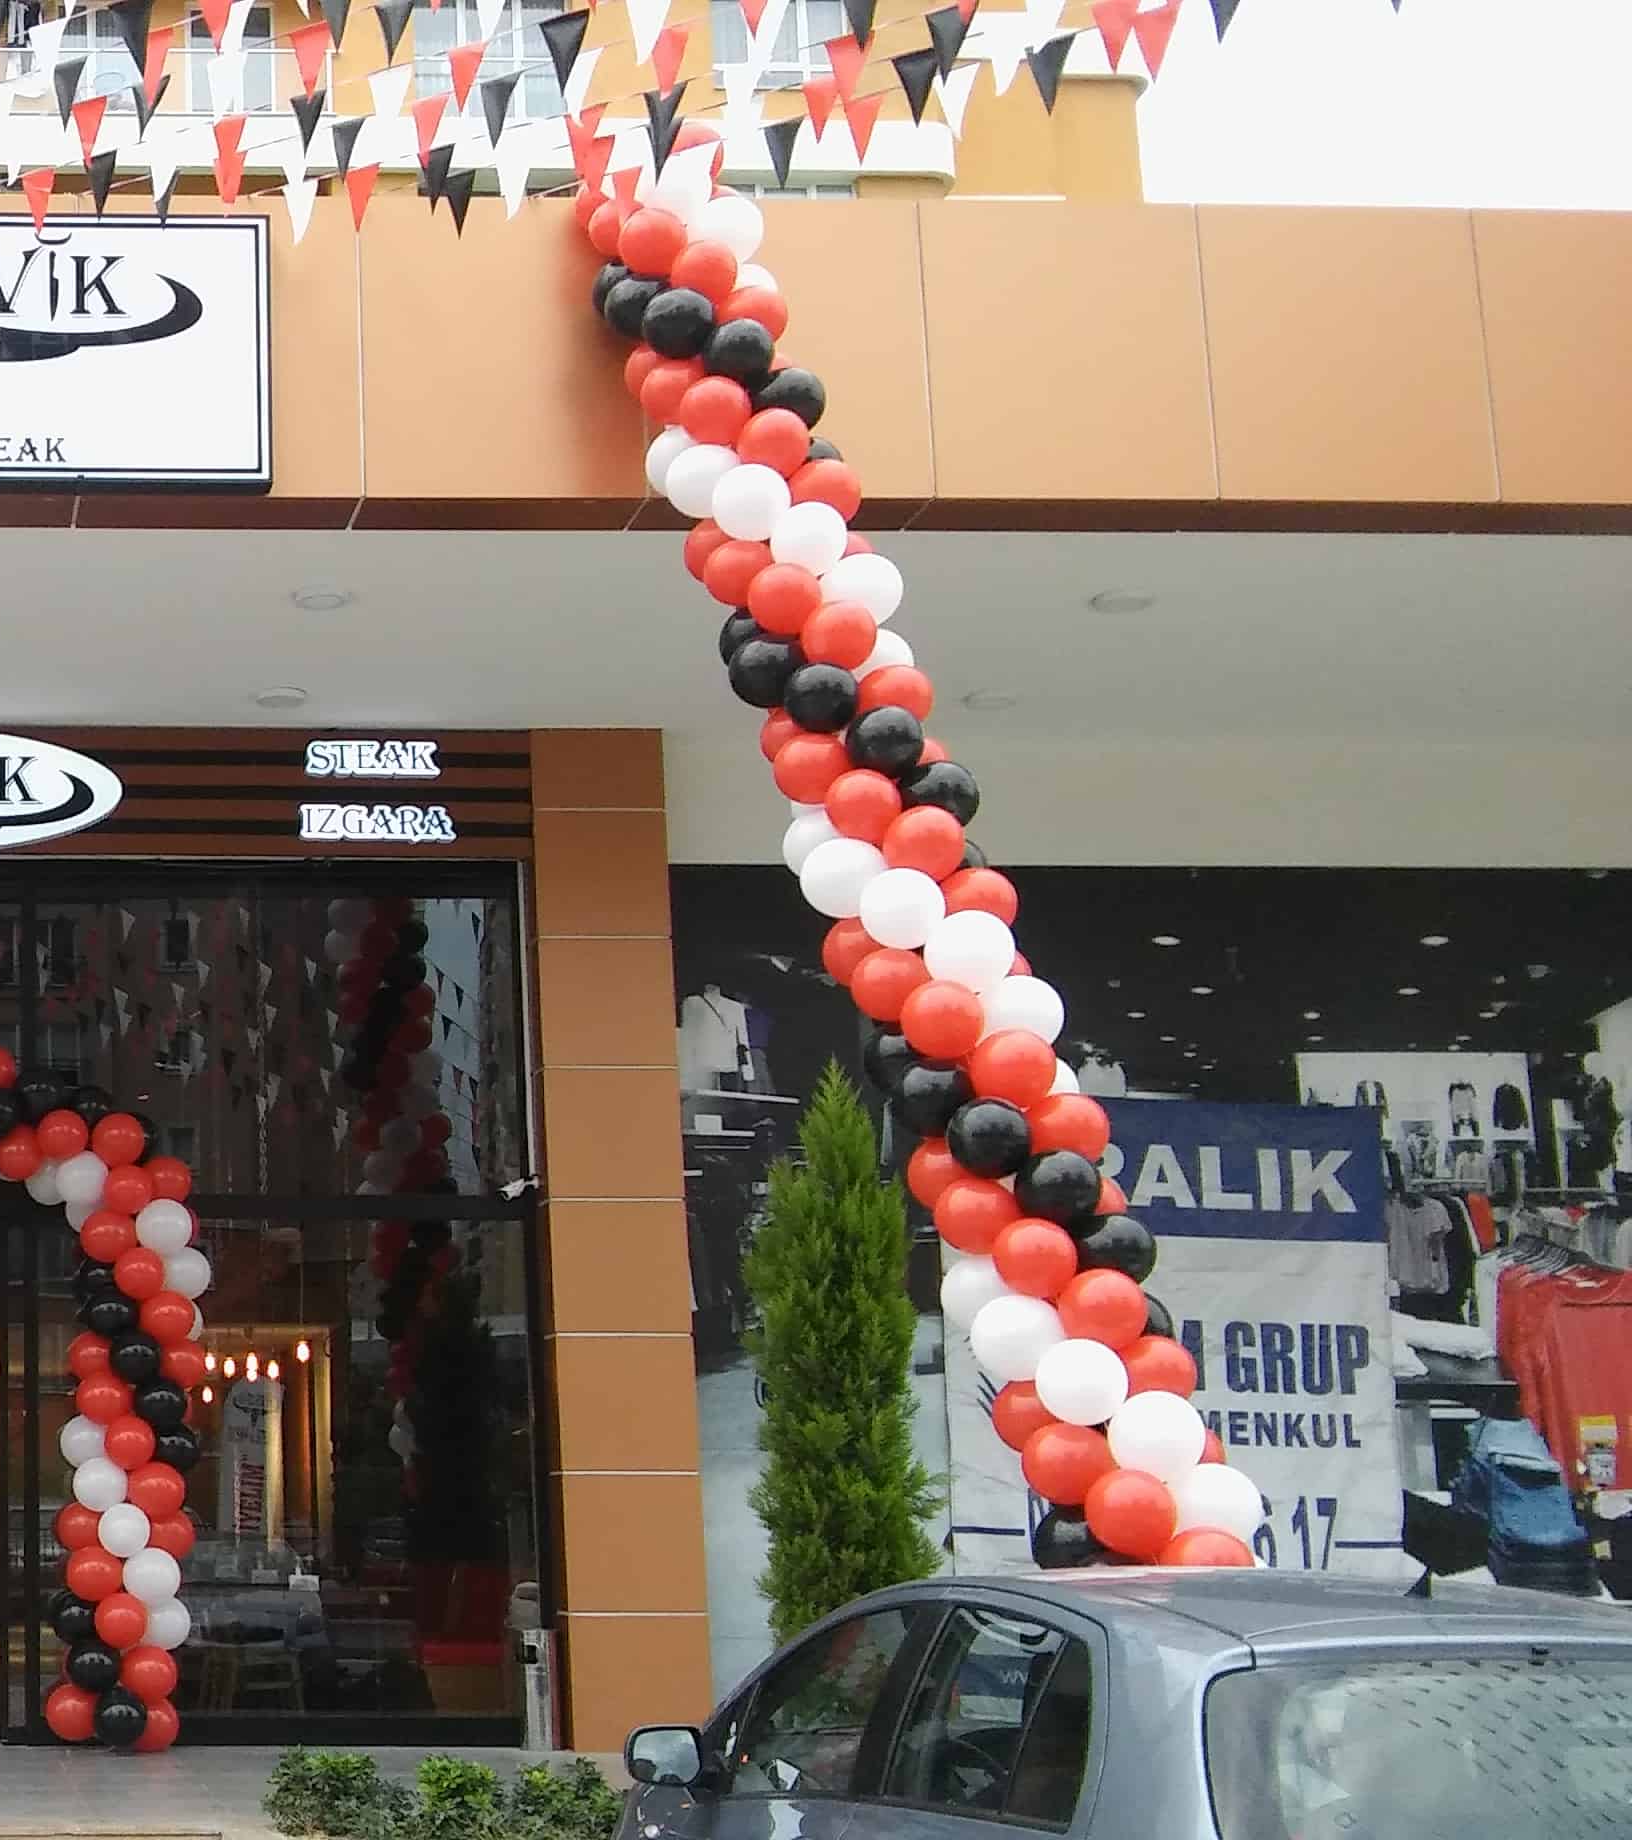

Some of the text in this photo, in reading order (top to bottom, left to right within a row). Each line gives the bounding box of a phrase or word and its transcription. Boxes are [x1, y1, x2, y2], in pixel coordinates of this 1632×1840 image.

[309, 743, 437, 771] STEAK
[303, 807, 451, 838] IZGARA
[1224, 1320, 1369, 1395] GRUP
